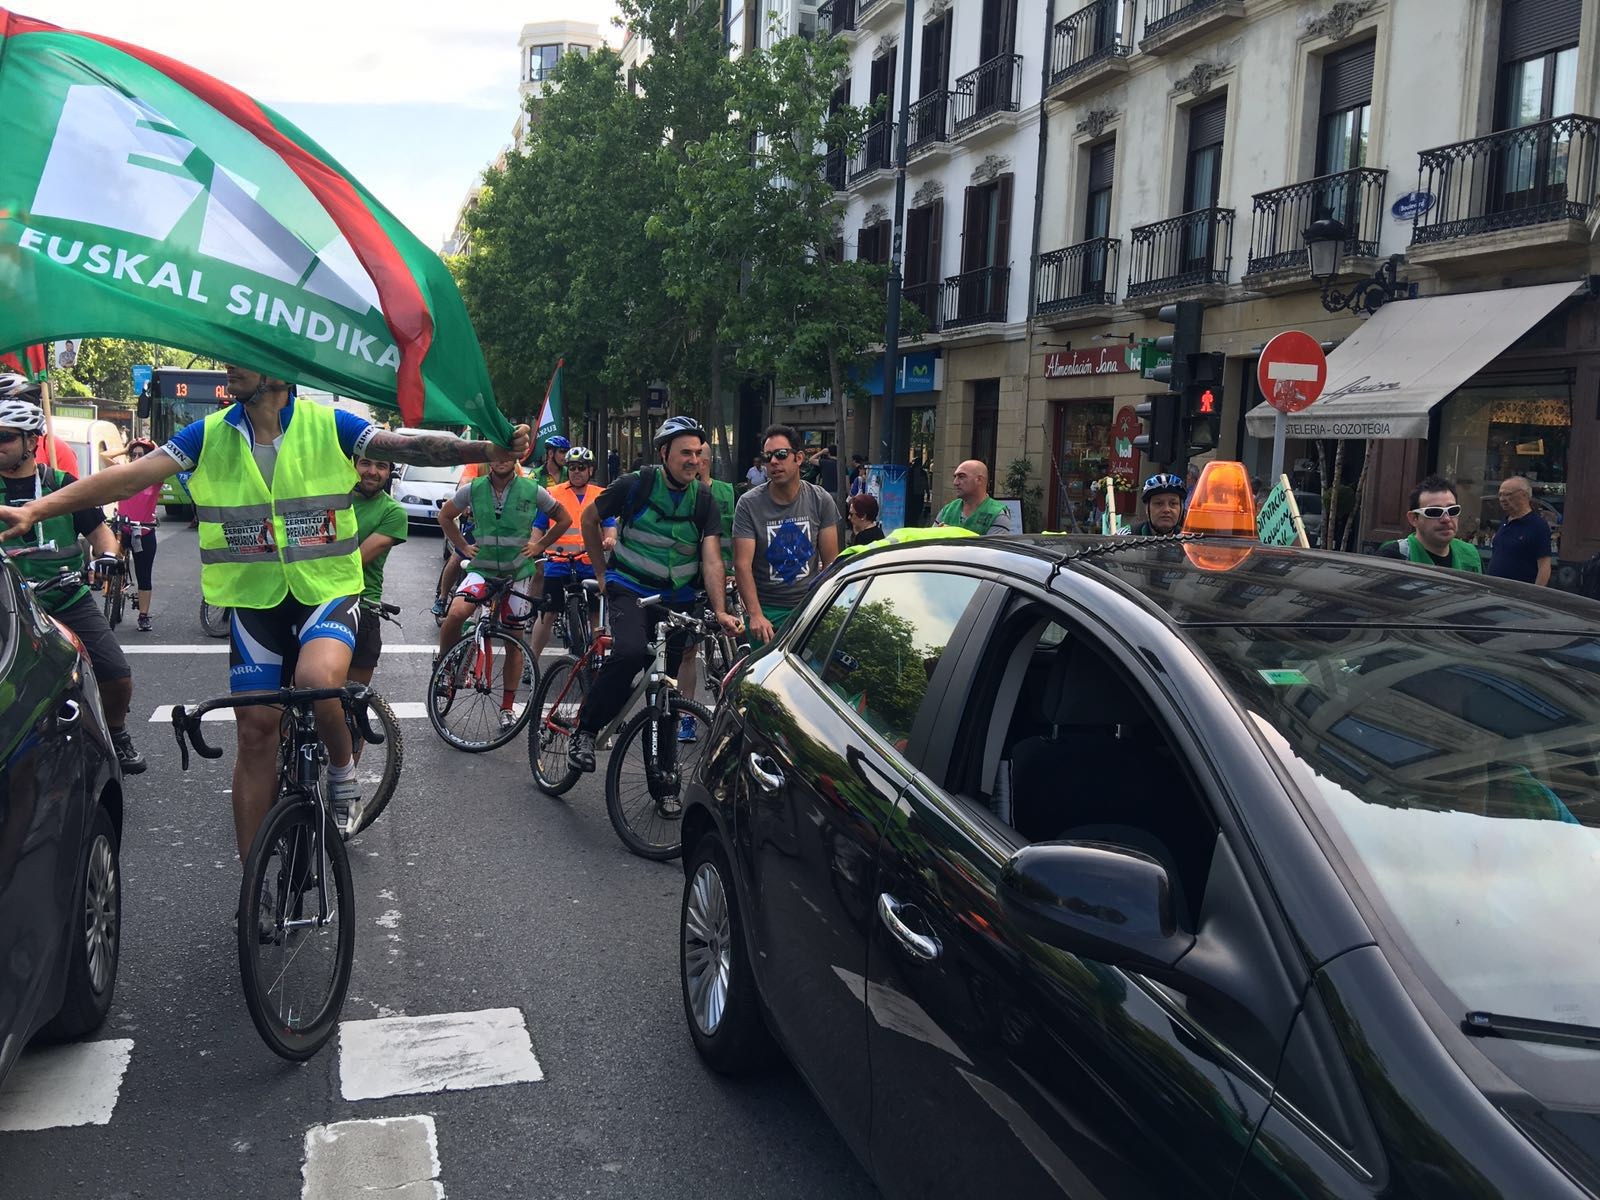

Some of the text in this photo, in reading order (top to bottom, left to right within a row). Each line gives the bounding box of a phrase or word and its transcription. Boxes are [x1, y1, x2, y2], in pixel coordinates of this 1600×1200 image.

[18, 227, 209, 304] EUSKAL
[1045, 352, 1092, 377] Alimentación
[1096, 348, 1118, 373] Sana
[176, 383, 188, 397] 13
[1274, 424, 1325, 435] STELERIA
[1333, 423, 1390, 435] GOZOTEGIA
[285, 517, 322, 526] ZERBITZU
[223, 526, 260, 536] ZERBITZU
